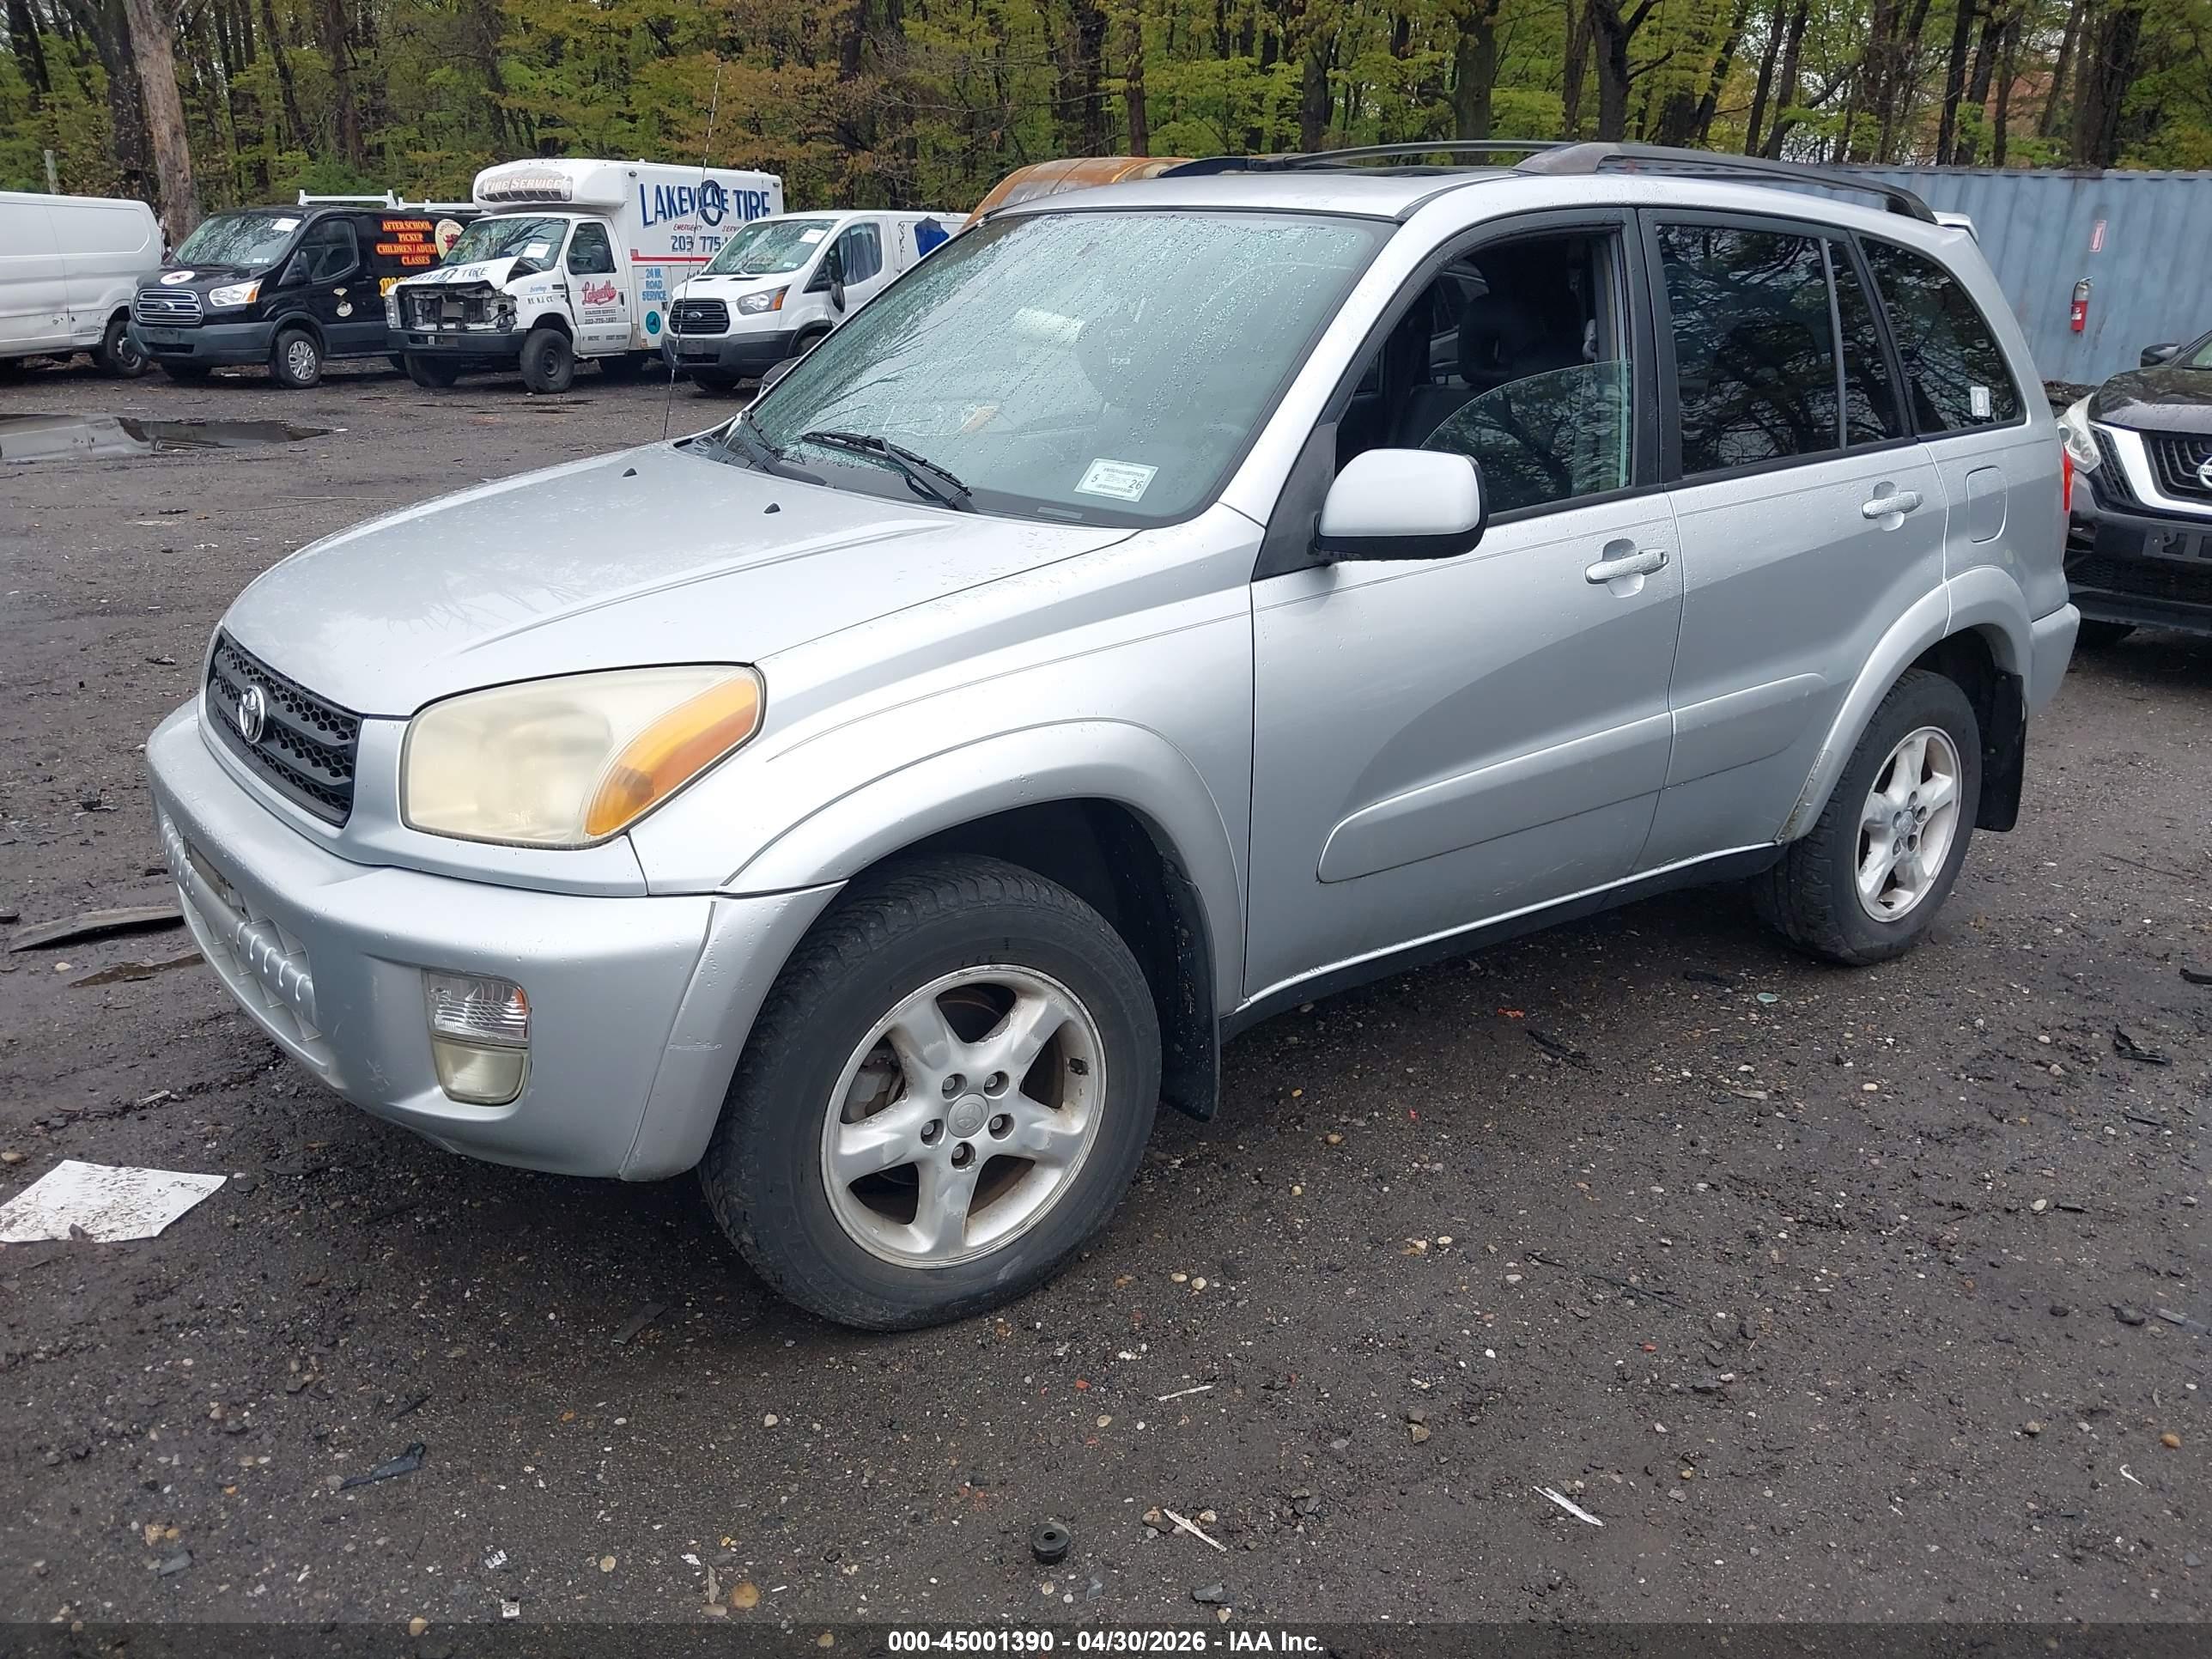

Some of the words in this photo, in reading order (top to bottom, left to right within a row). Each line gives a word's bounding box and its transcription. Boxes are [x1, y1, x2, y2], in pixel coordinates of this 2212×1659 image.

[510, 177, 562, 190] SERVICE
[639, 183, 730, 229] LAKEVILLE
[732, 189, 771, 222] TIRE
[383, 221, 404, 231] AFTER
[404, 221, 433, 231] SCHOOL
[398, 233, 423, 242] PICKUP
[671, 235, 694, 252] 203
[699, 235, 731, 252] 775-1
[377, 244, 413, 253] CHILDREN
[416, 244, 437, 254] ADULT
[401, 256, 430, 265] CLASSES
[646, 268, 653, 278] 24
[646, 280, 663, 290] ROAD
[641, 290, 667, 301] SERVICE
[1128, 478, 1144, 490] 26
